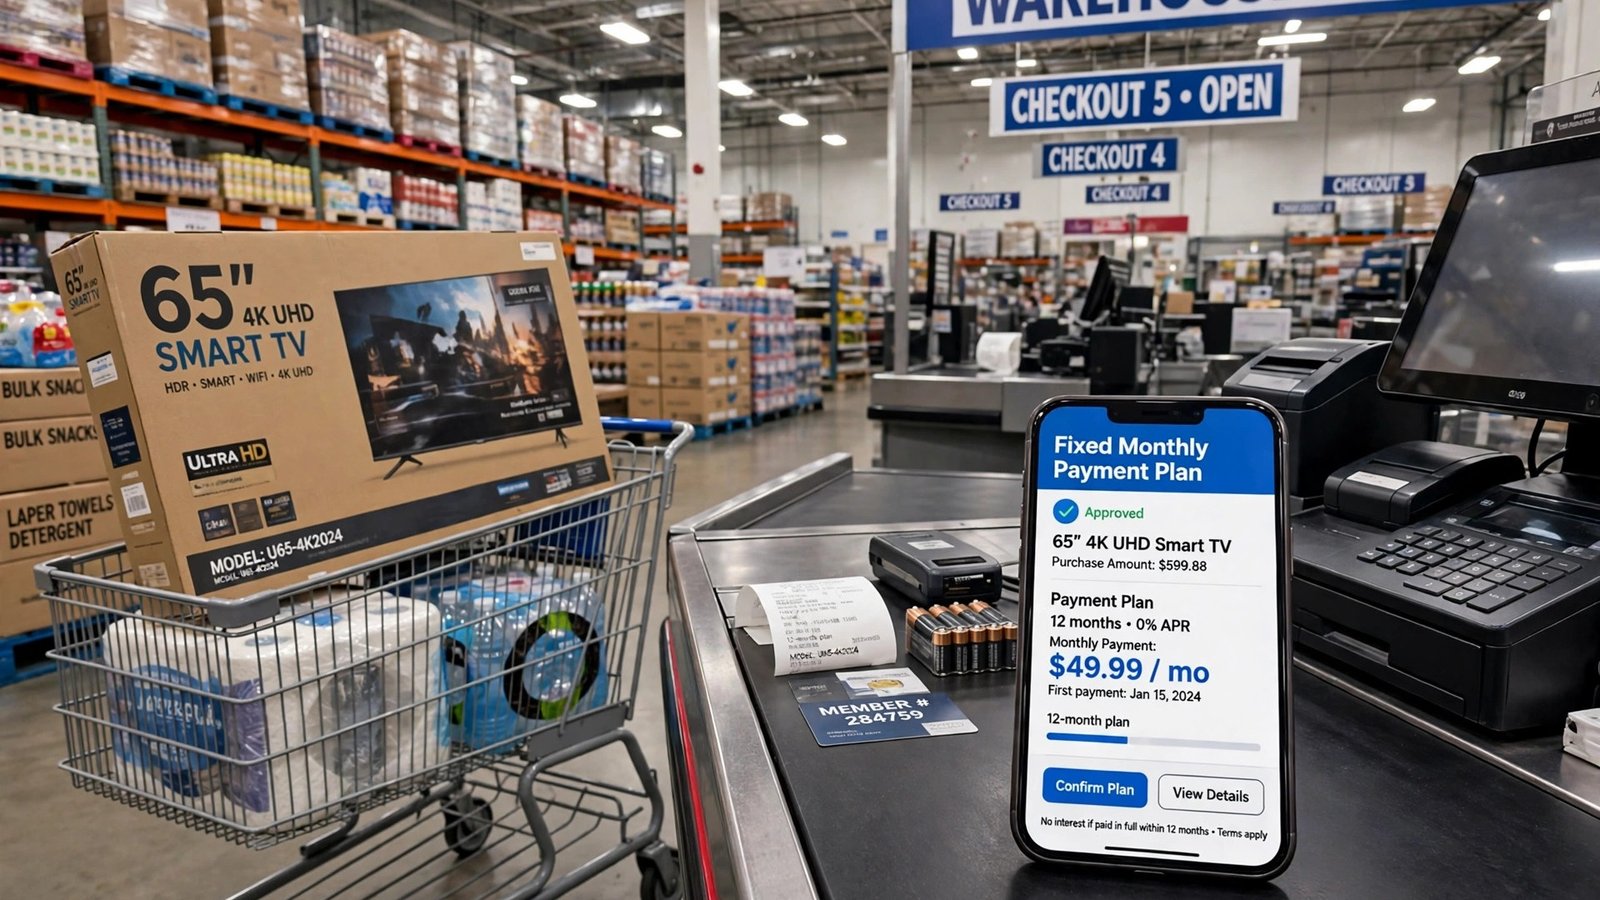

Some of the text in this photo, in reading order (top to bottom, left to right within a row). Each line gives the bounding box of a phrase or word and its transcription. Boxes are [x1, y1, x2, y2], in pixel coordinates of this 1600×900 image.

[1012, 81, 1145, 123] CHECKOUT
[1153, 79, 1171, 116] 5
[1199, 72, 1273, 113] OPEN
[1049, 142, 1166, 172] CHECKOUT 4
[1092, 185, 1161, 202] CHECKOUT 4
[1333, 176, 1400, 193] CHECKOUT
[947, 195, 999, 209] CHECKOUT
[140, 263, 314, 333] 65" 4K UHD
[156, 330, 305, 372] SMART TV
[1, 380, 42, 399] BULK
[164, 380, 190, 394] HDR
[200, 375, 235, 389] SMART
[245, 371, 268, 383] WIFI
[278, 368, 291, 379] 4K
[292, 366, 313, 378] UHD
[3, 429, 44, 449] BULK
[1053, 435, 1209, 461] Fixed Monthly
[187, 450, 239, 470] ULTRA
[239, 443, 267, 462] HD
[1054, 460, 1202, 483] Payment Plan
[7, 494, 114, 528] LAPER TOWELS
[1085, 507, 1144, 520] Approved
[9, 518, 93, 549] DETERGENT
[210, 549, 265, 576] MODEL:
[266, 528, 343, 560] U65-4K2024
[1086, 535, 1108, 549] 4K
[1113, 536, 1150, 550] UHD
[1155, 537, 1204, 553] Smart
[1209, 539, 1232, 553] TV
[1052, 556, 1207, 572] Purchase Amount: $599.88
[1051, 592, 1153, 609] Payment Plan
[1051, 614, 1066, 627] 12
[1070, 616, 1122, 630] months
[1136, 618, 1157, 631] 0%
[1160, 619, 1190, 632] APR
[1050, 636, 1156, 653] Monthly Payment:
[1049, 652, 1209, 683] $49.99 / mo
[1048, 684, 1201, 702] First payment: Jan 15, 2024
[818, 698, 929, 717] MEMBER #
[845, 710, 923, 726] 284759
[1047, 713, 1130, 729] 12-month plan
[1056, 780, 1134, 795] Confirm Plan
[1173, 786, 1249, 803] View Details
[1041, 817, 1053, 826] No
[1054, 817, 1086, 828] interest
[1087, 819, 1094, 828] if
[1095, 820, 1113, 831] paid
[1114, 821, 1122, 830] in
[1124, 821, 1138, 831] full
[1139, 823, 1165, 833] within
[1167, 824, 1176, 834] 12
[1178, 826, 1209, 836] months
[1217, 827, 1243, 838] Terms
[1244, 830, 1268, 842] apply
